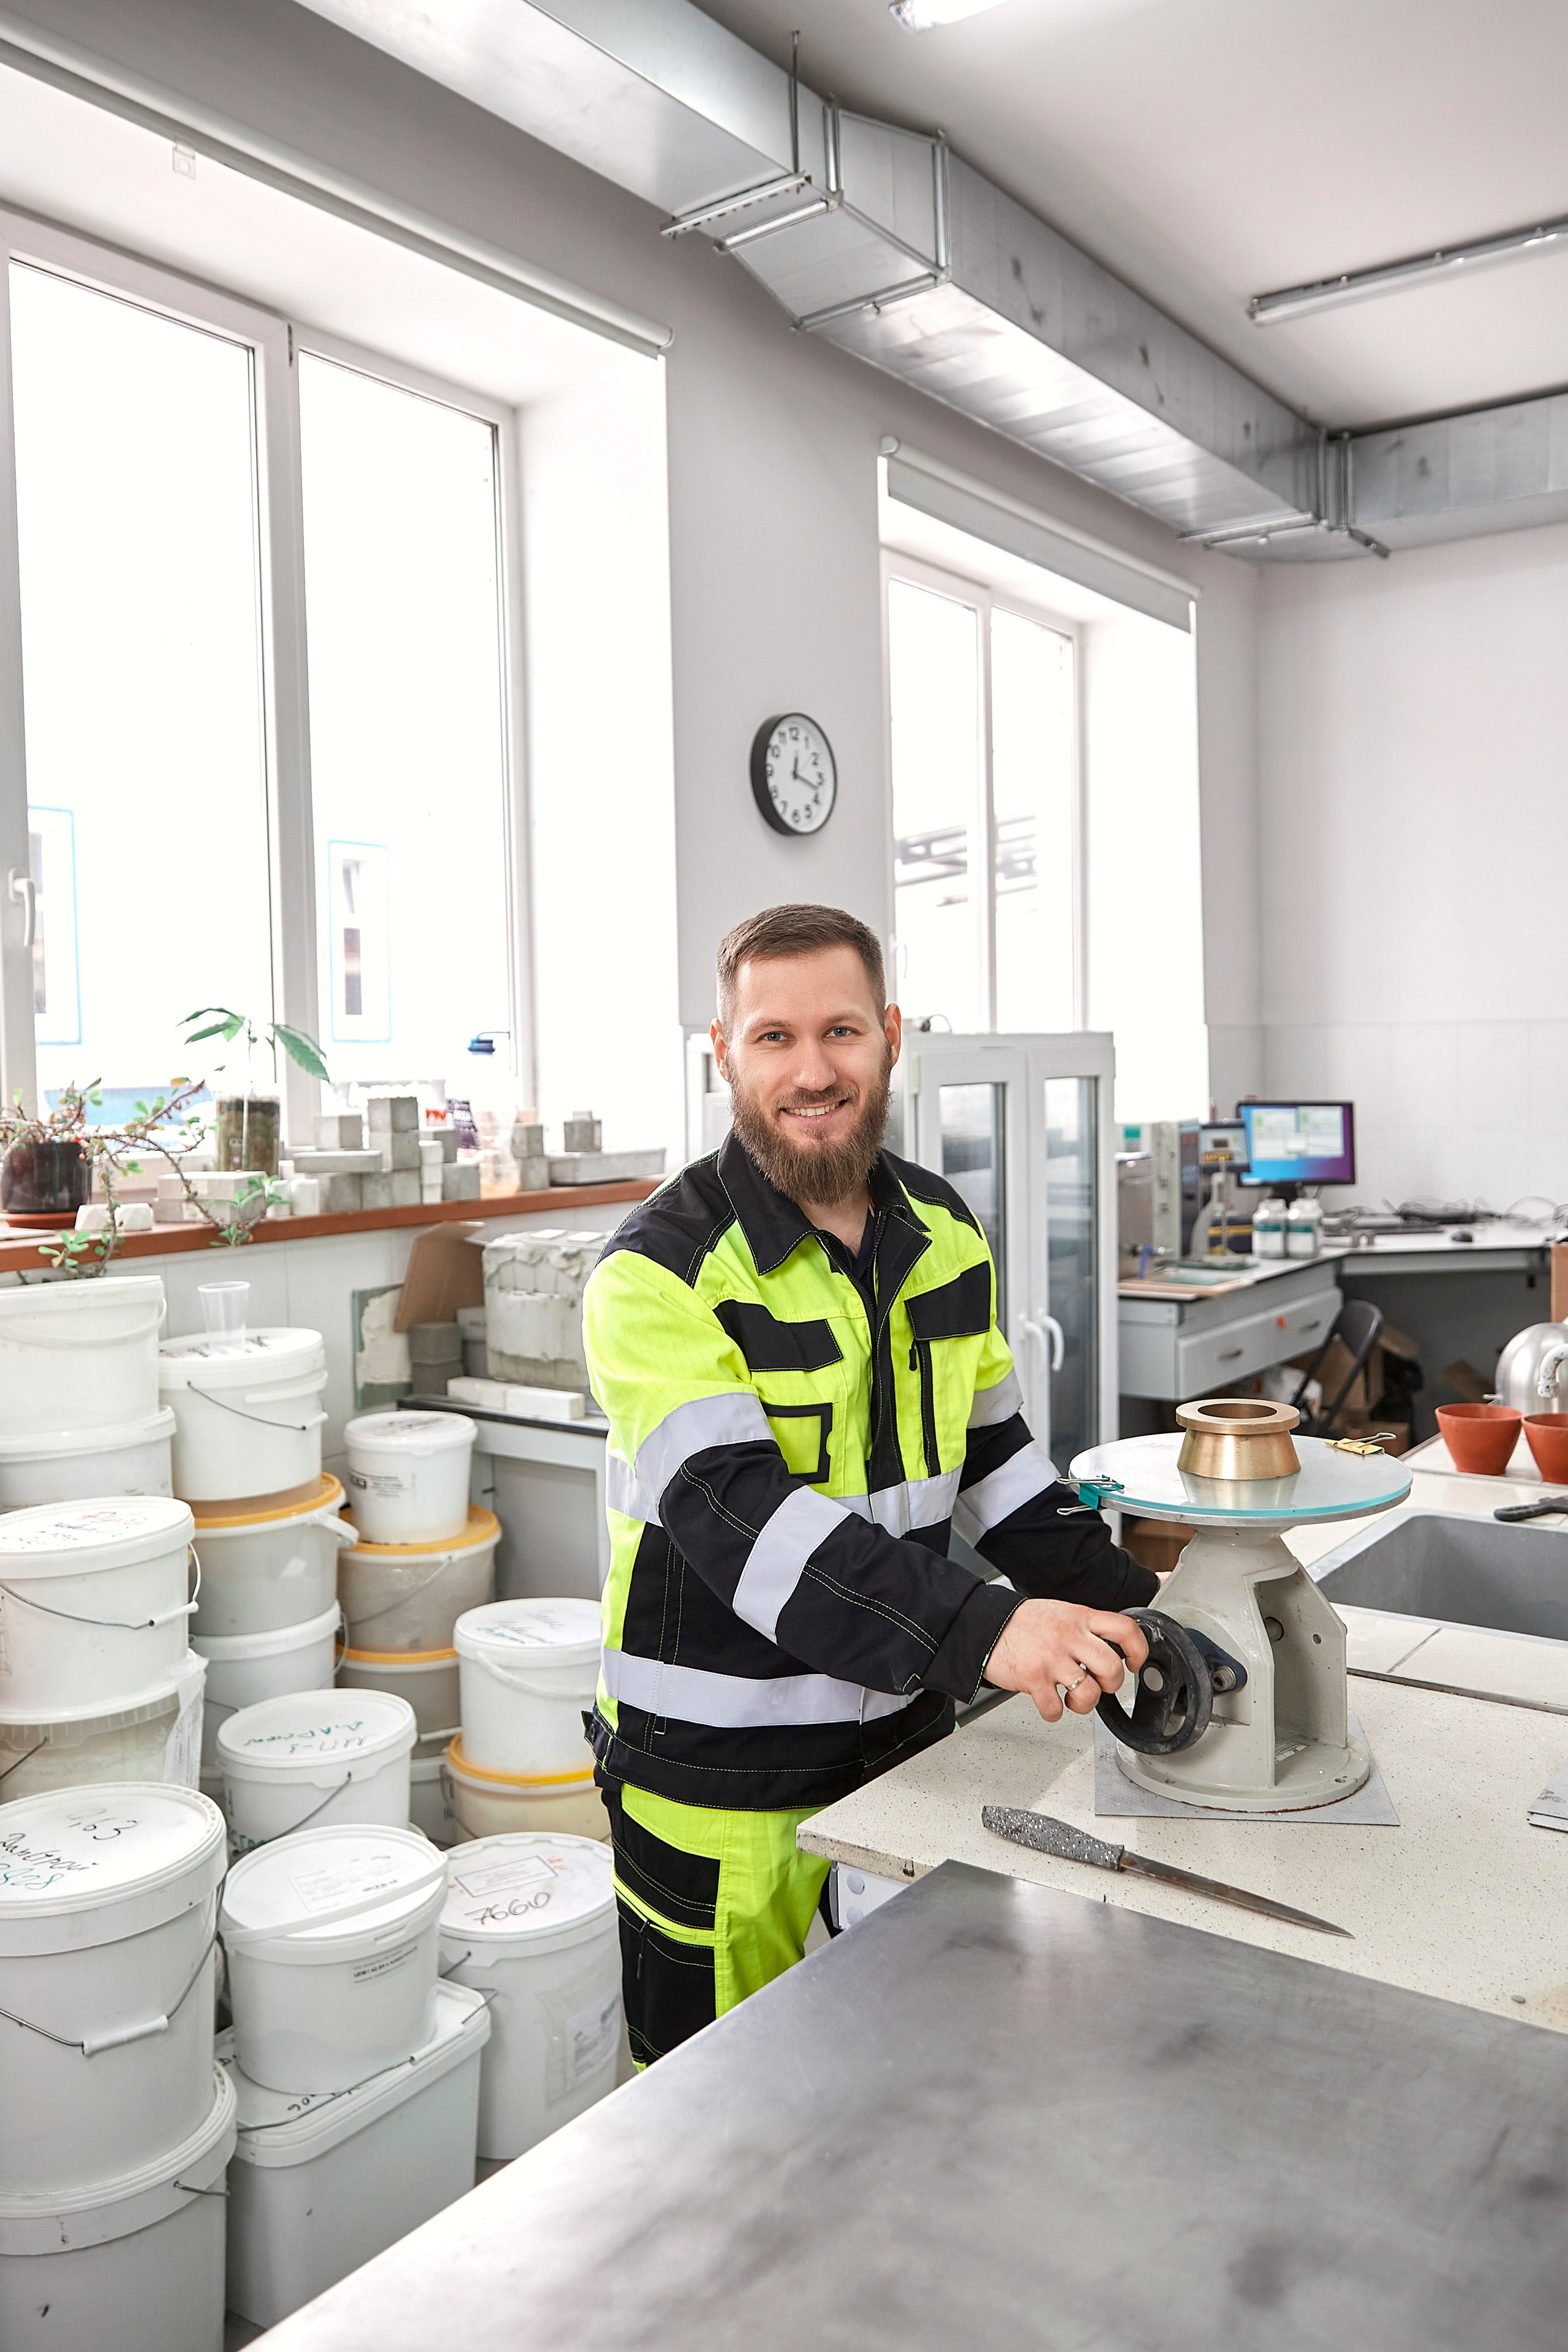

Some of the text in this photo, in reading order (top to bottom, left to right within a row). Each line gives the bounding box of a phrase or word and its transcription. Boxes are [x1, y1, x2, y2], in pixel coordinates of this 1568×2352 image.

[789, 726, 799, 740] 12
[804, 737, 810, 749] 1
[811, 753, 820, 766] 2
[766, 764, 774, 777] 9
[817, 772, 824, 785] 3
[771, 785, 778, 799] 8
[813, 793, 821, 805] 4
[780, 801, 788, 814] 7
[804, 804, 812, 818] 5
[792, 809, 801, 823] 6
[464, 1891, 551, 1925] 7660
